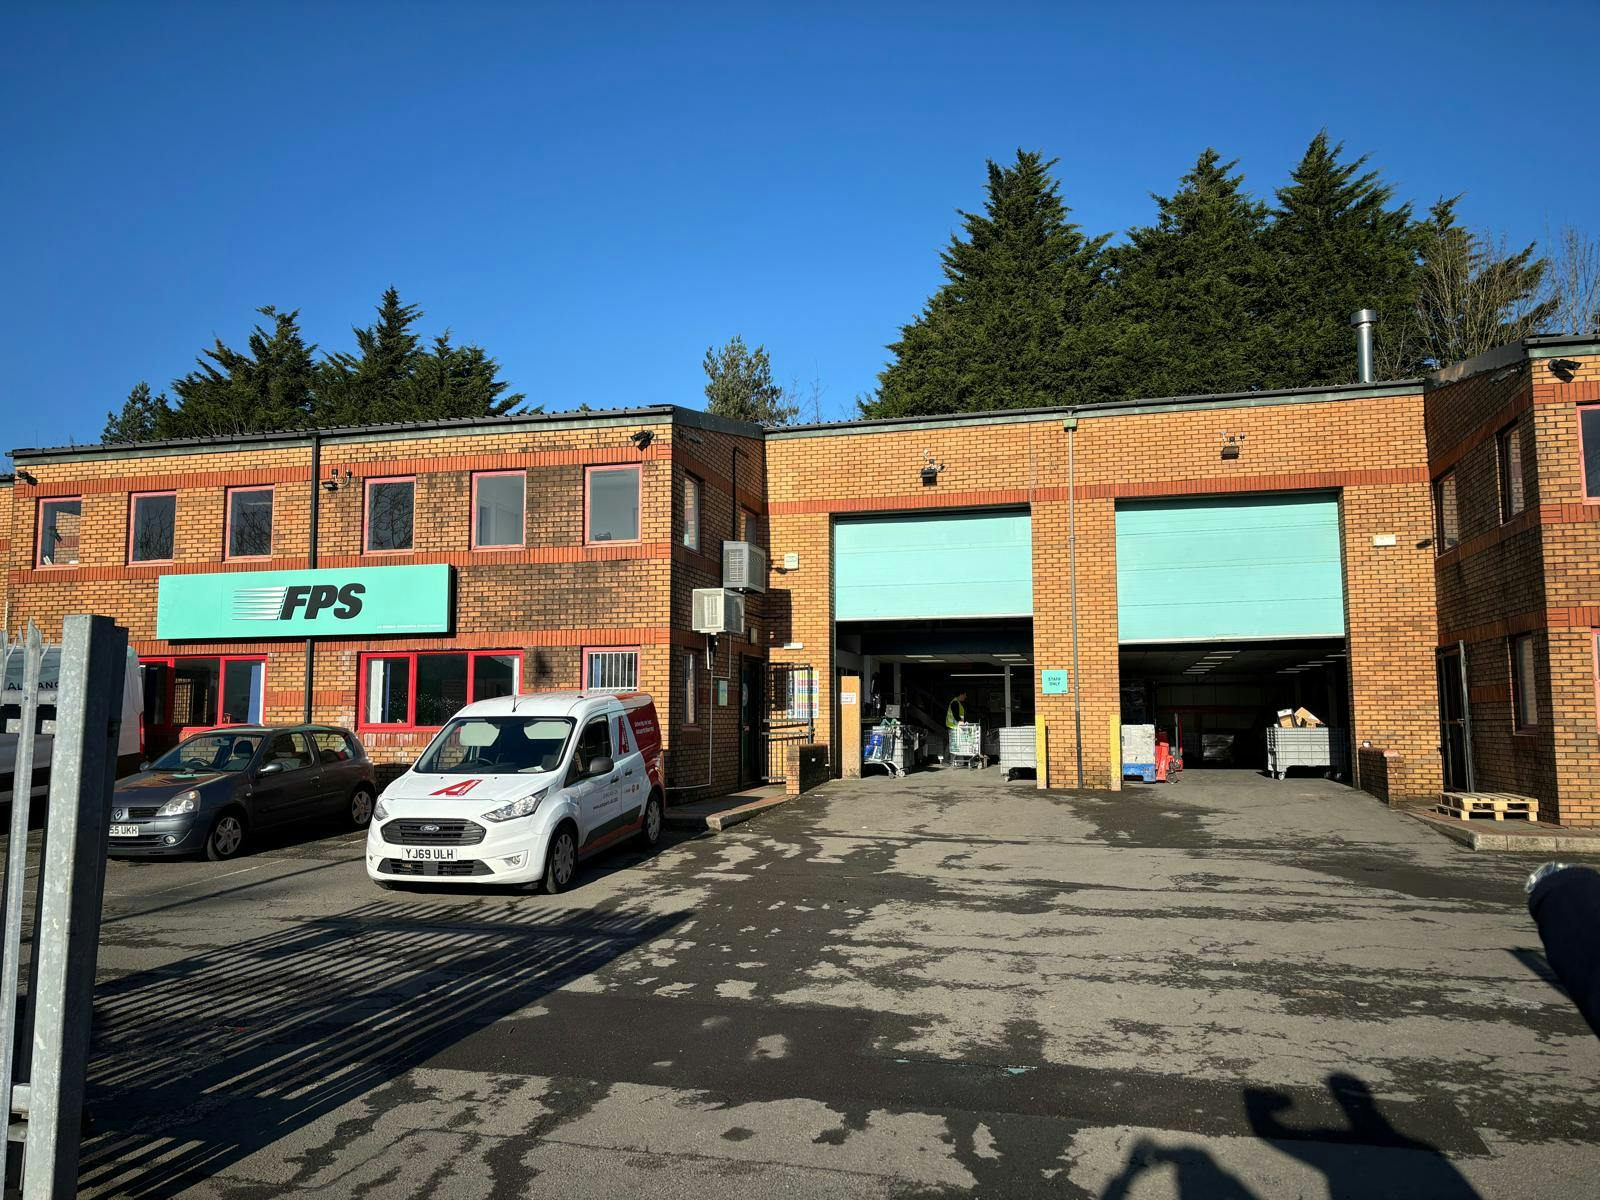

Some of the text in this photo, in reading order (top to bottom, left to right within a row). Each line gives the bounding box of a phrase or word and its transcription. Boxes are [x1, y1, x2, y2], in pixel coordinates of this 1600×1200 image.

[280, 583, 366, 620] FPS
[121, 826, 138, 835] UKH
[405, 848, 454, 860] YJ69 ULH
